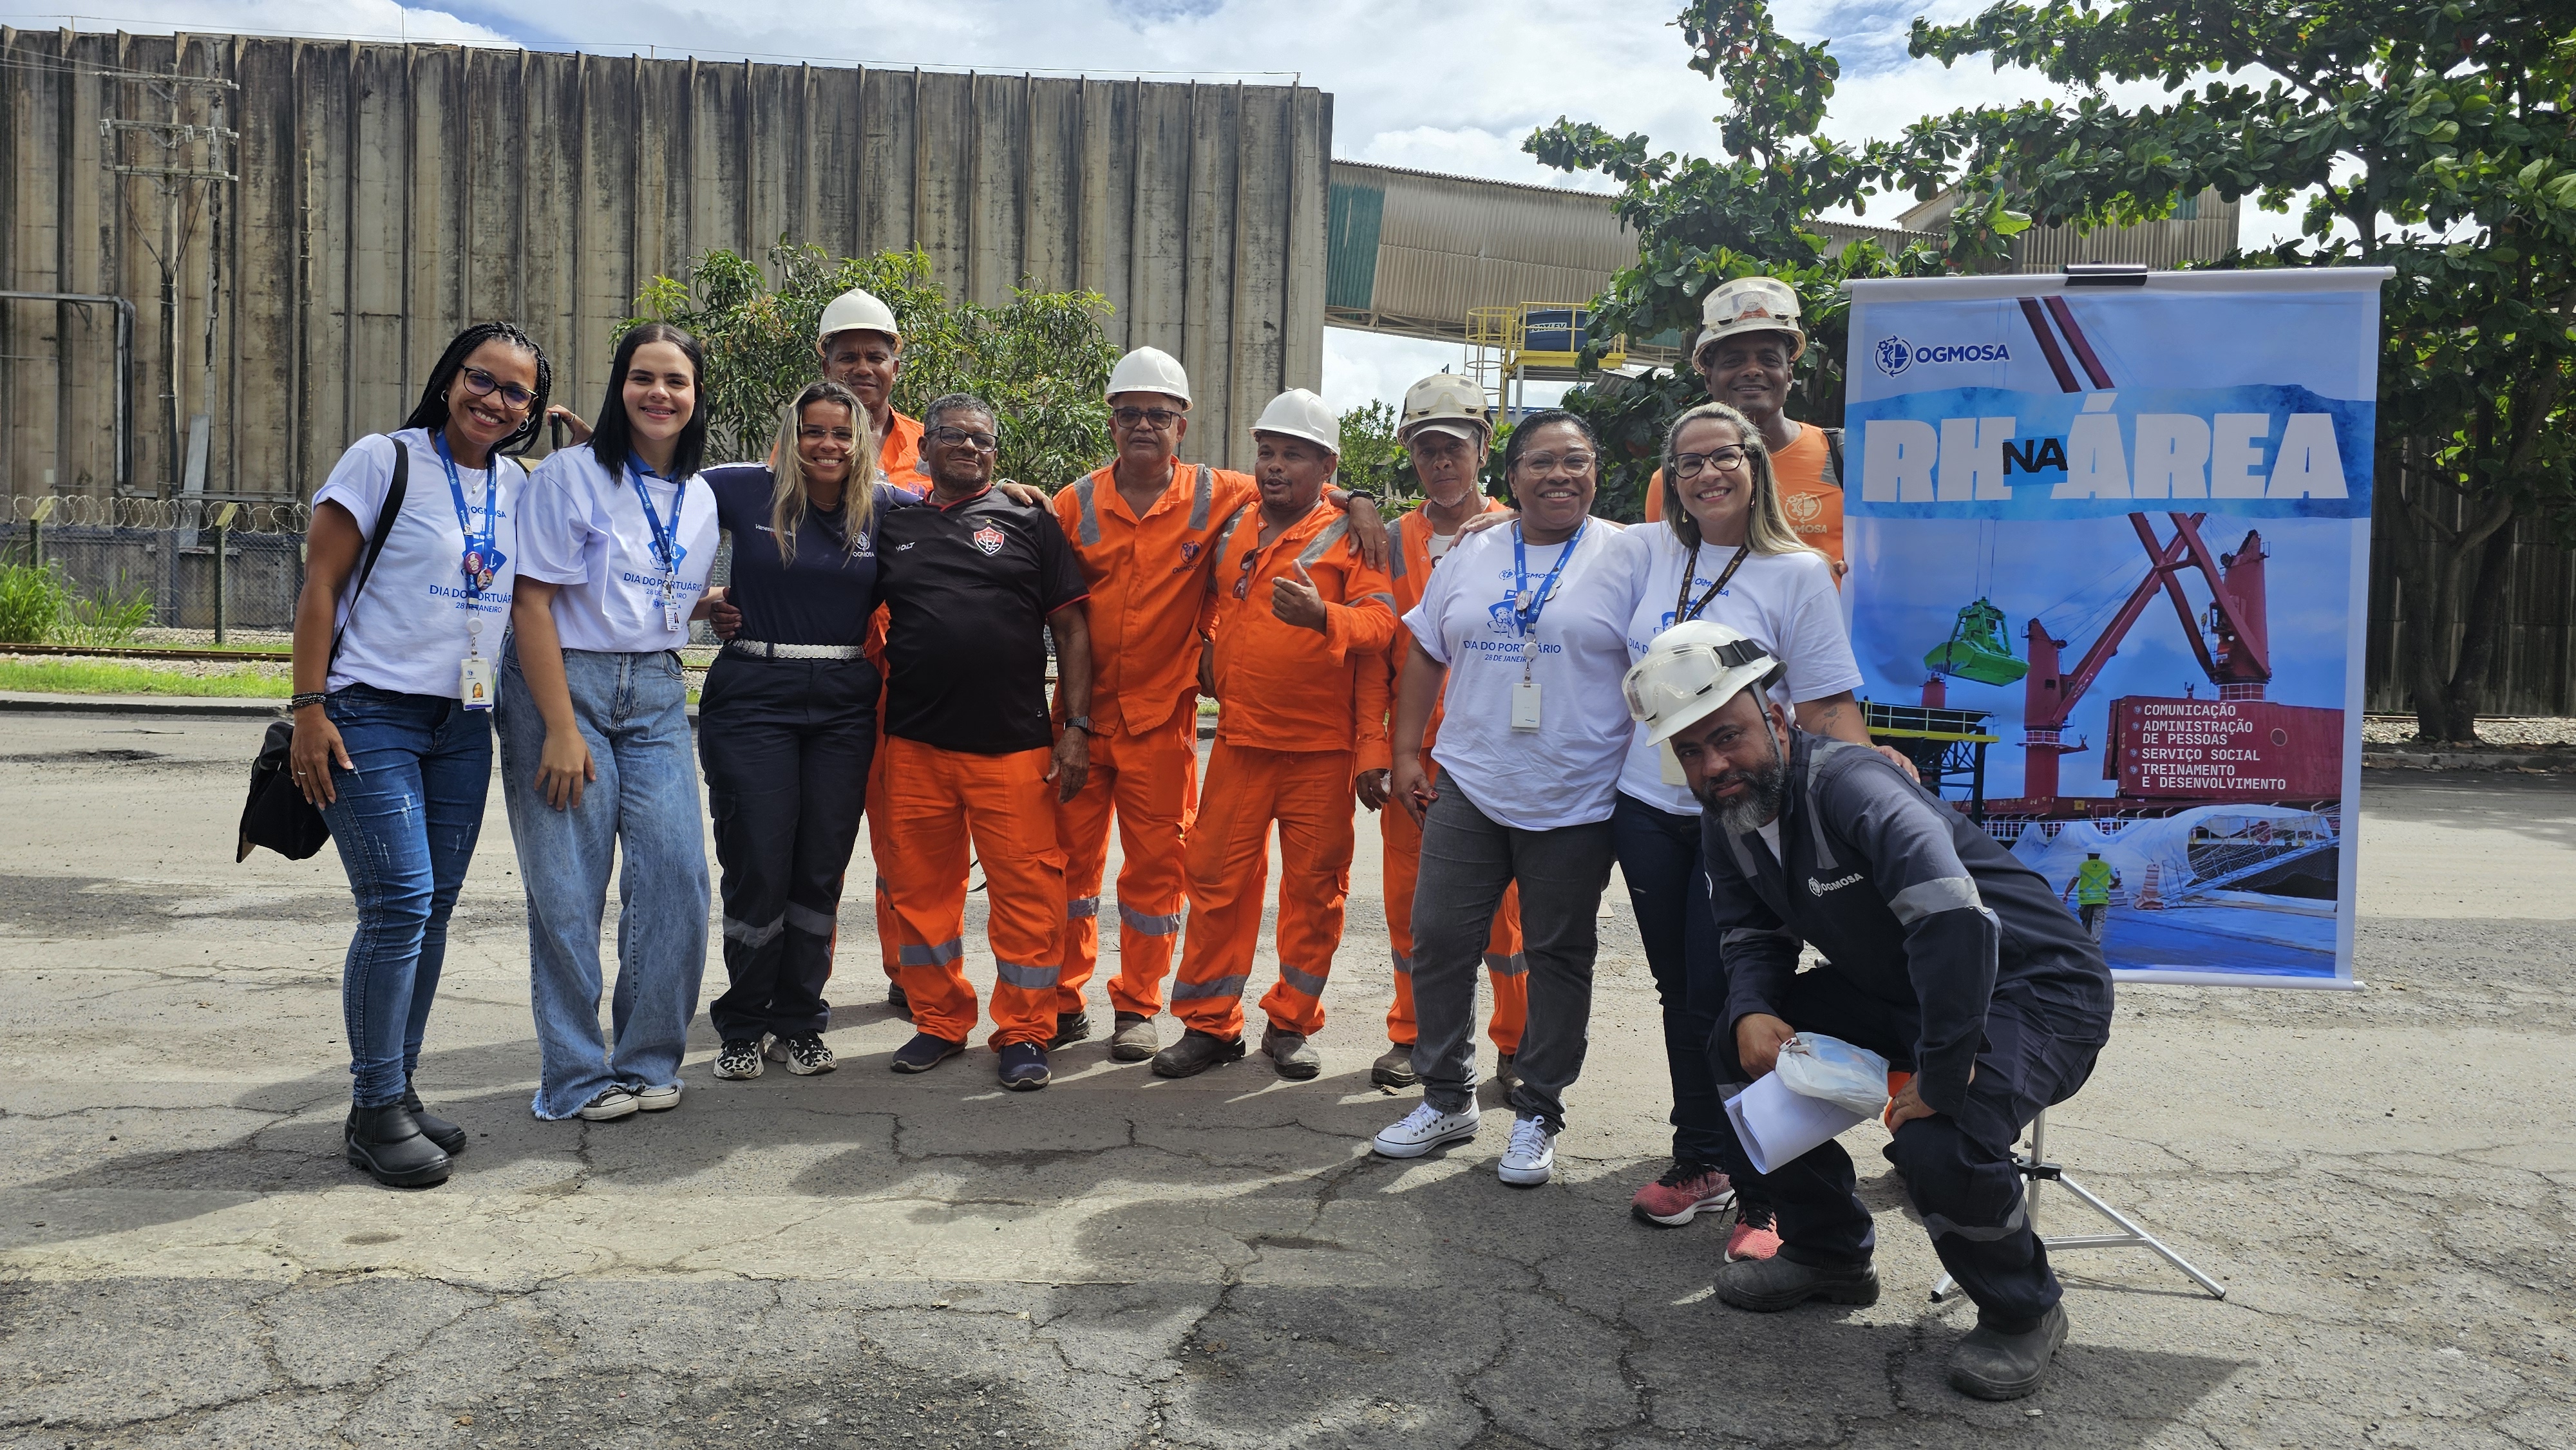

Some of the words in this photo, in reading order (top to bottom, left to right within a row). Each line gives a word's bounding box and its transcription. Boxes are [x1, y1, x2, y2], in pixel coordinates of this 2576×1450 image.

[1915, 344, 2010, 363] OGMOSA
[1862, 417, 2016, 503] RH
[2002, 438, 2068, 475] NA
[2050, 392, 2349, 499] ÁREA
[470, 506, 507, 518] OGSA
[623, 572, 640, 583] DIA
[642, 576, 656, 586] DO
[430, 585, 450, 597] DIA
[451, 588, 468, 599] DO
[1481, 641, 1496, 650] DO
[1498, 643, 1561, 654] PORTÁRIO
[1629, 637, 1640, 652] DIA
[2144, 702, 2236, 719] COMUNICAÇÃO
[2143, 719, 2253, 735] ADMINISTRAÇÃO
[2142, 733, 2159, 744] DE
[2168, 733, 2228, 745] PESSOAS
[2141, 748, 2202, 762] SERVIÇO
[2210, 749, 2260, 761] SOCIAL
[2141, 764, 2235, 776] TREINAMENTO
[2142, 777, 2150, 787] E
[2159, 777, 2286, 790] DESENVOLVIMENTO
[1821, 872, 1864, 891] OGMOSA
